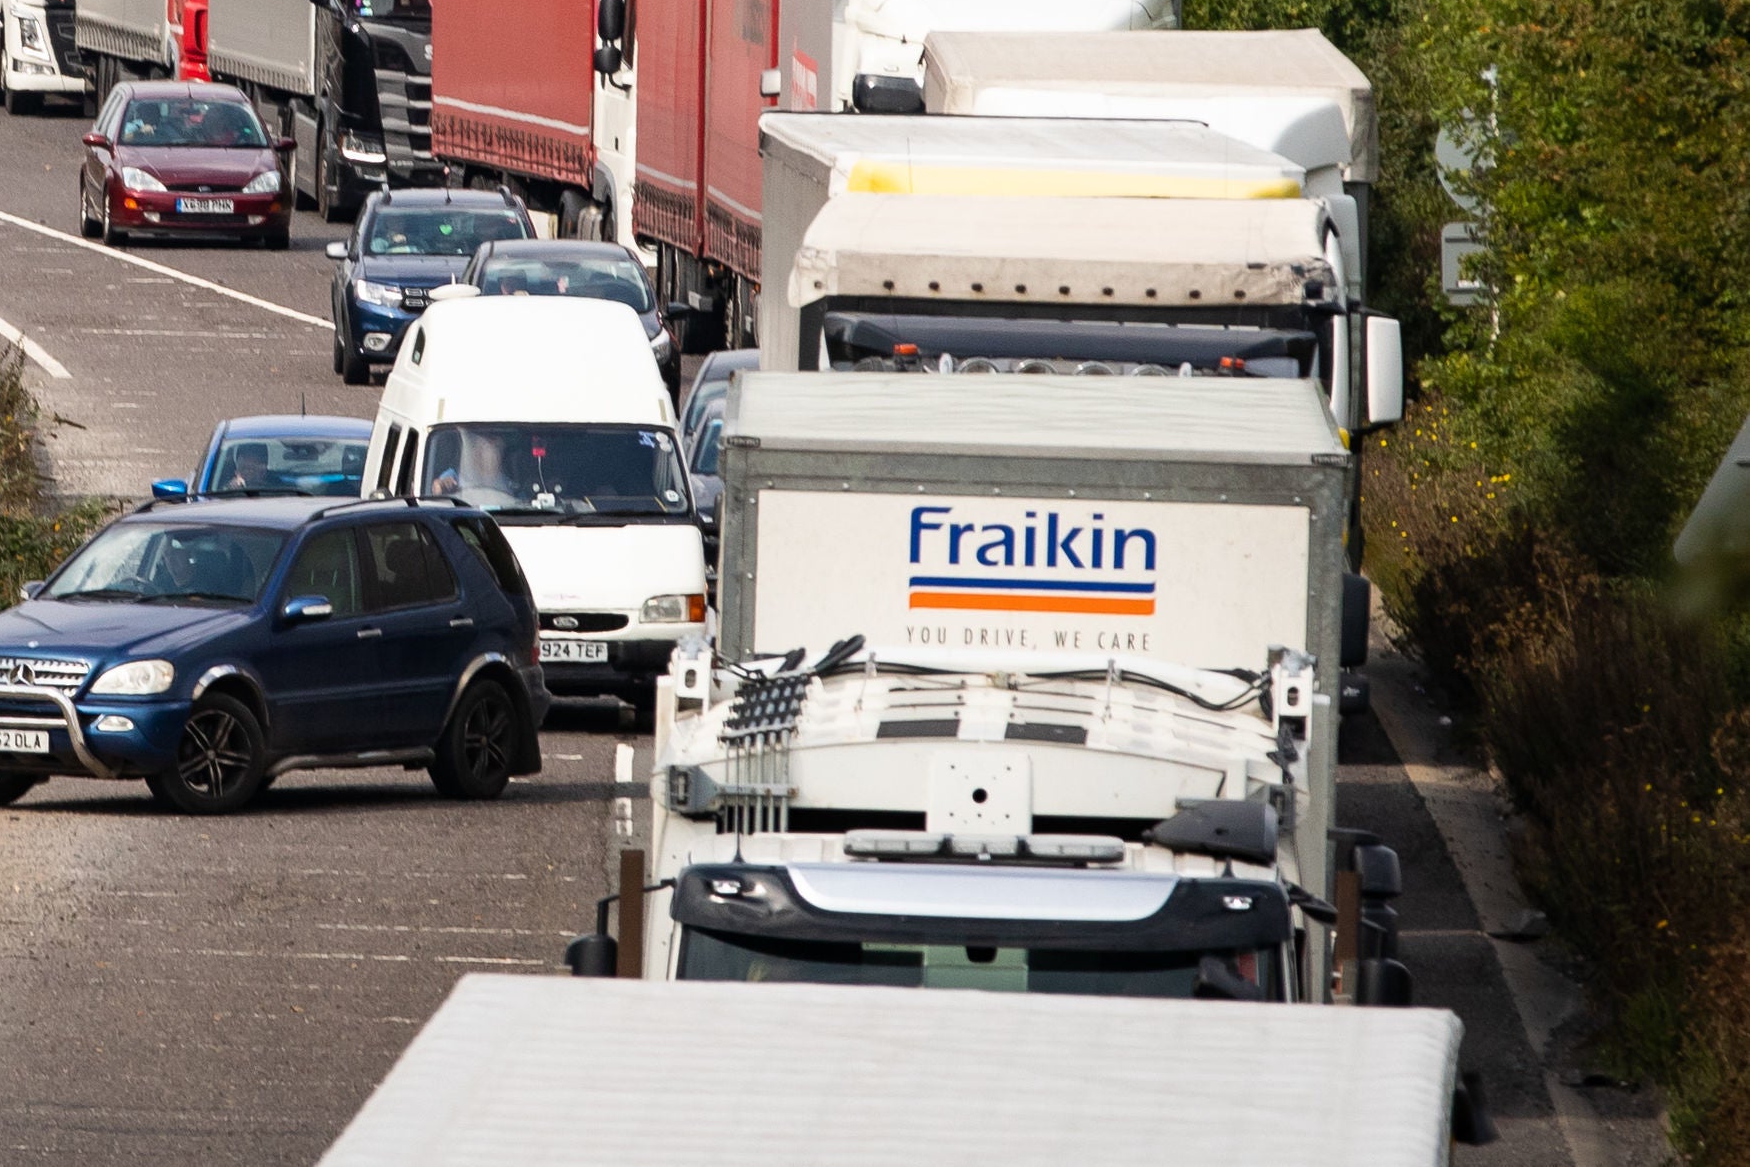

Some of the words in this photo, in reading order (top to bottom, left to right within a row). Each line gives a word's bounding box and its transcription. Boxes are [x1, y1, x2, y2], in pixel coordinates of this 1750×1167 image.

[909, 505, 1157, 571] Fraikin
[906, 625, 947, 645] YOU
[963, 627, 1038, 651] DRIVE,
[1054, 630, 1081, 649] WE
[1097, 631, 1151, 651] CARE
[541, 642, 571, 658] 924
[576, 642, 605, 659] TEF
[14, 732, 42, 750] OLA
